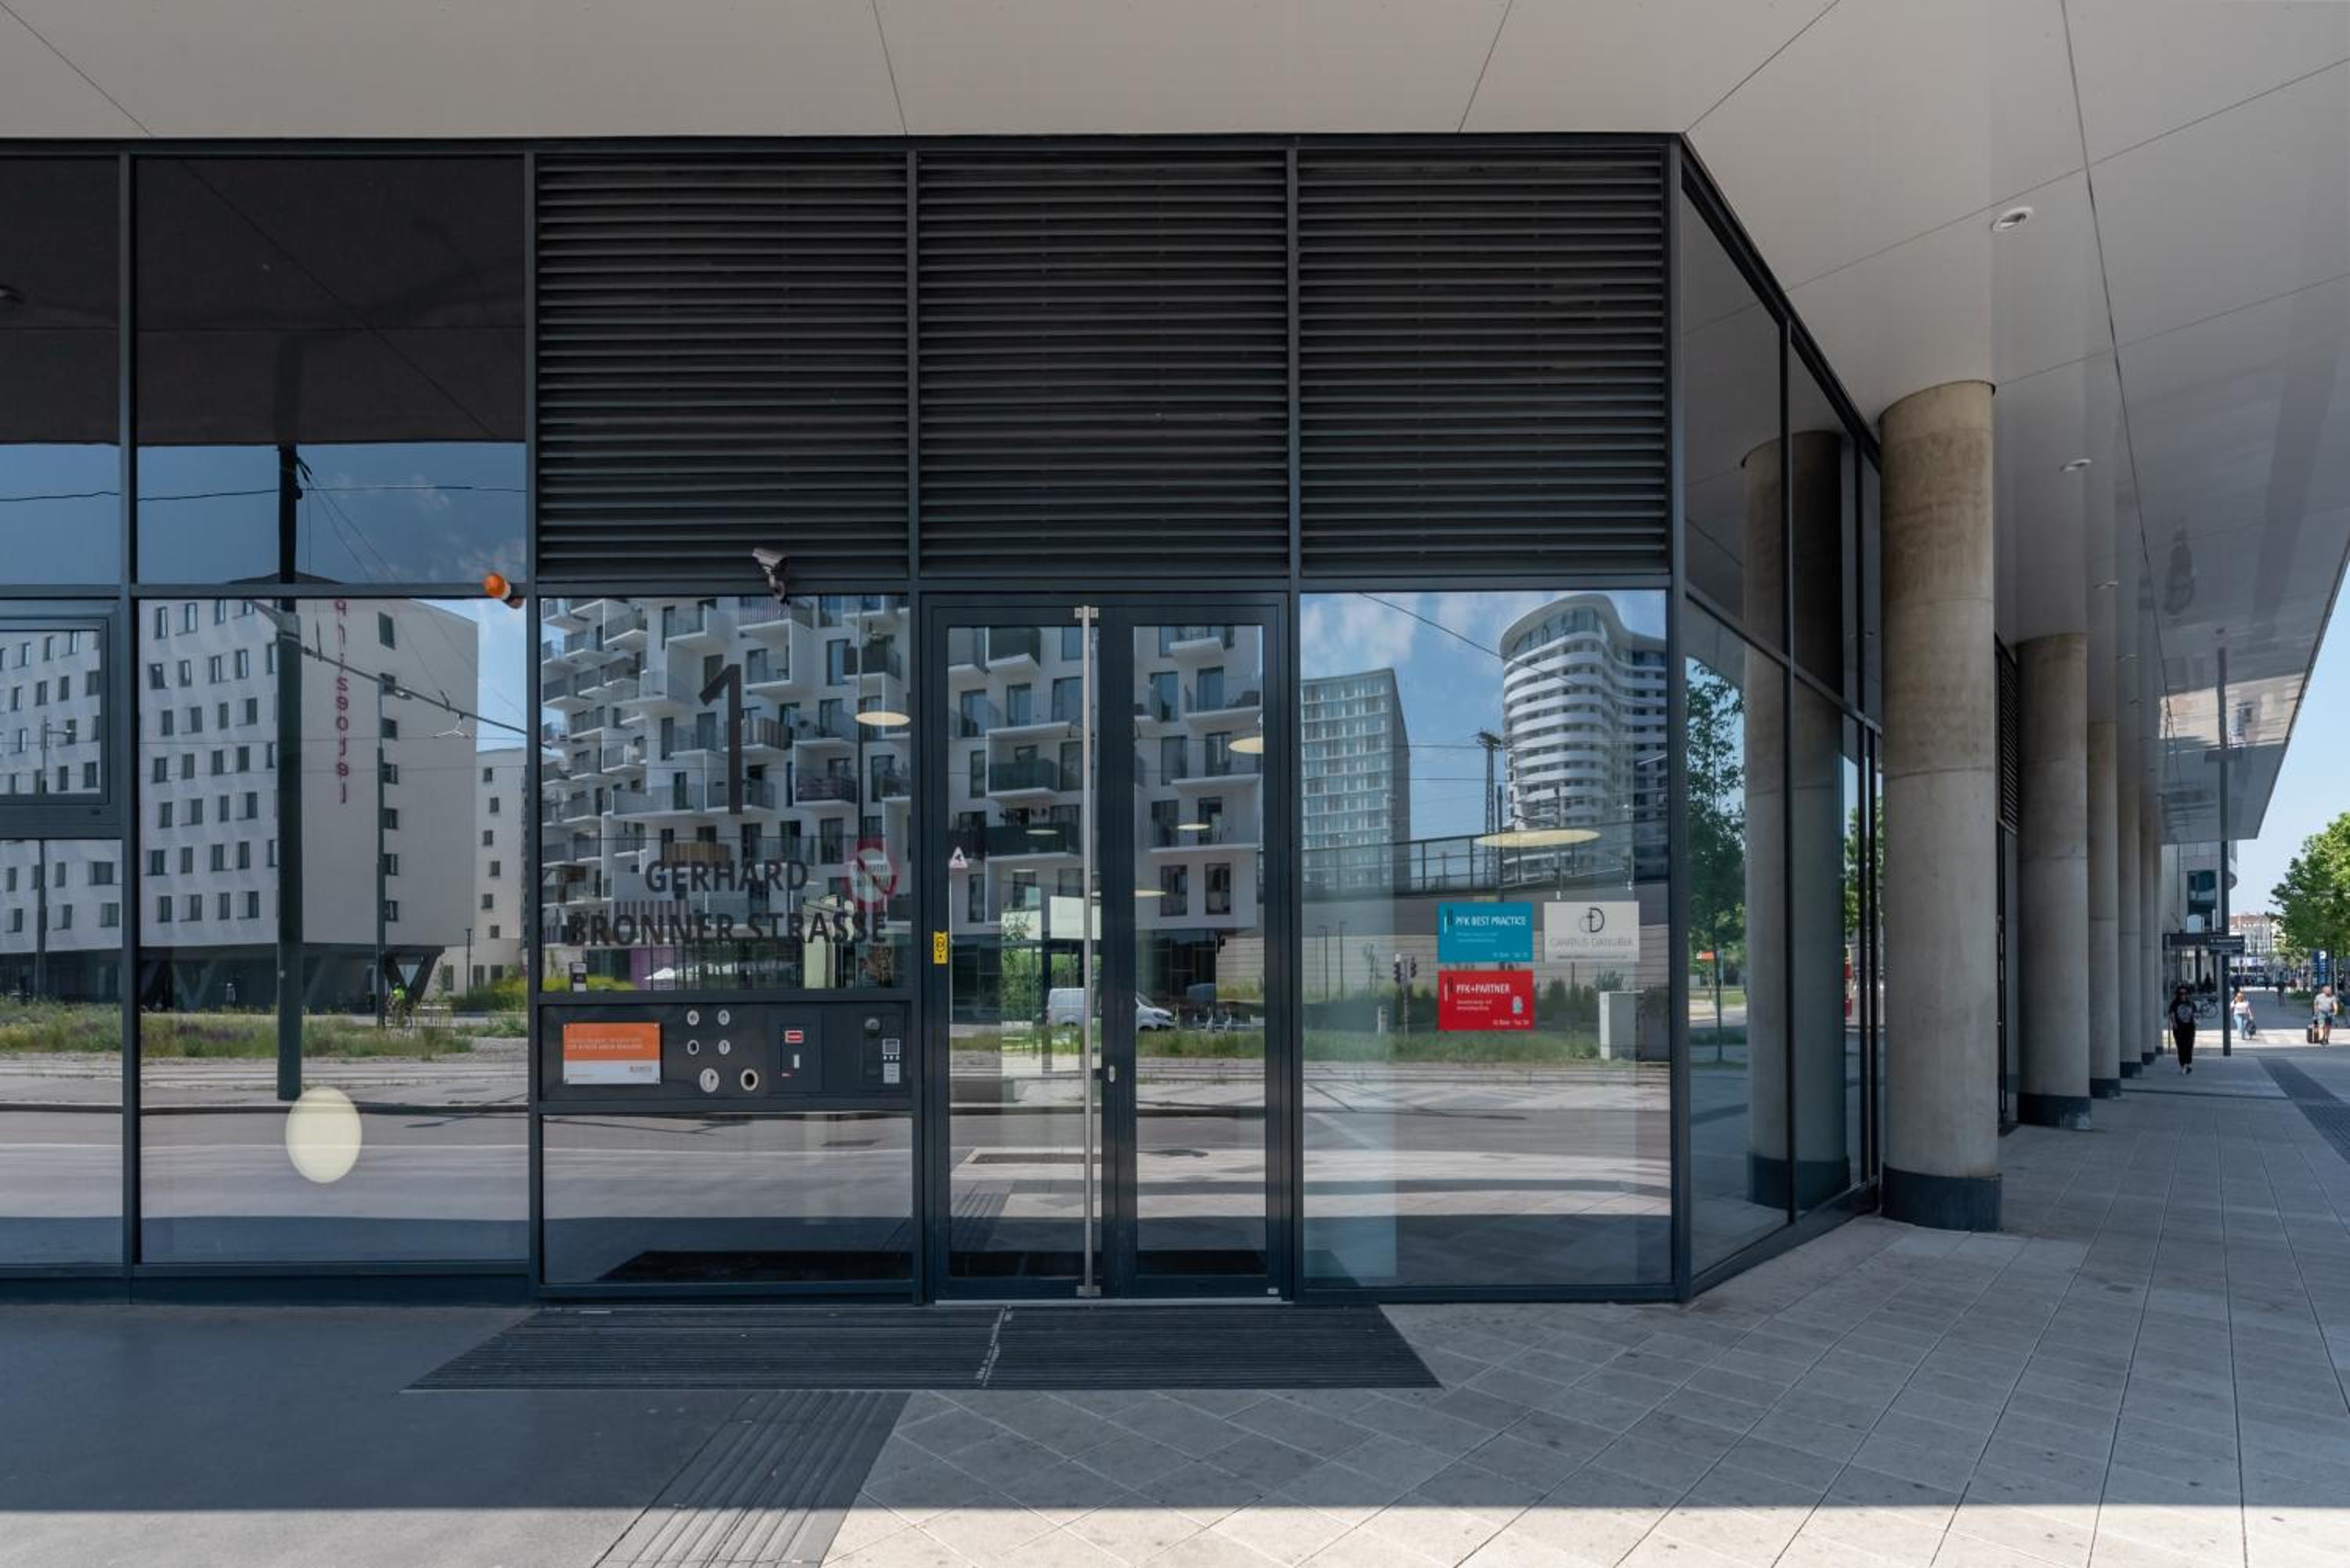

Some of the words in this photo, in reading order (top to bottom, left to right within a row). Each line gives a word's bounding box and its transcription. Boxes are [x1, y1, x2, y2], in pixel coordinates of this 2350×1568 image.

[700, 663, 743, 815] 1
[645, 861, 808, 894] GERHARD
[567, 912, 735, 946] BRONNER
[749, 911, 888, 945] STRASSE
[1455, 916, 1470, 927] PFK
[1471, 916, 1489, 927] BEST
[1491, 916, 1527, 927] PRACTICE
[1455, 983, 1511, 995] PFK+PARTNER
